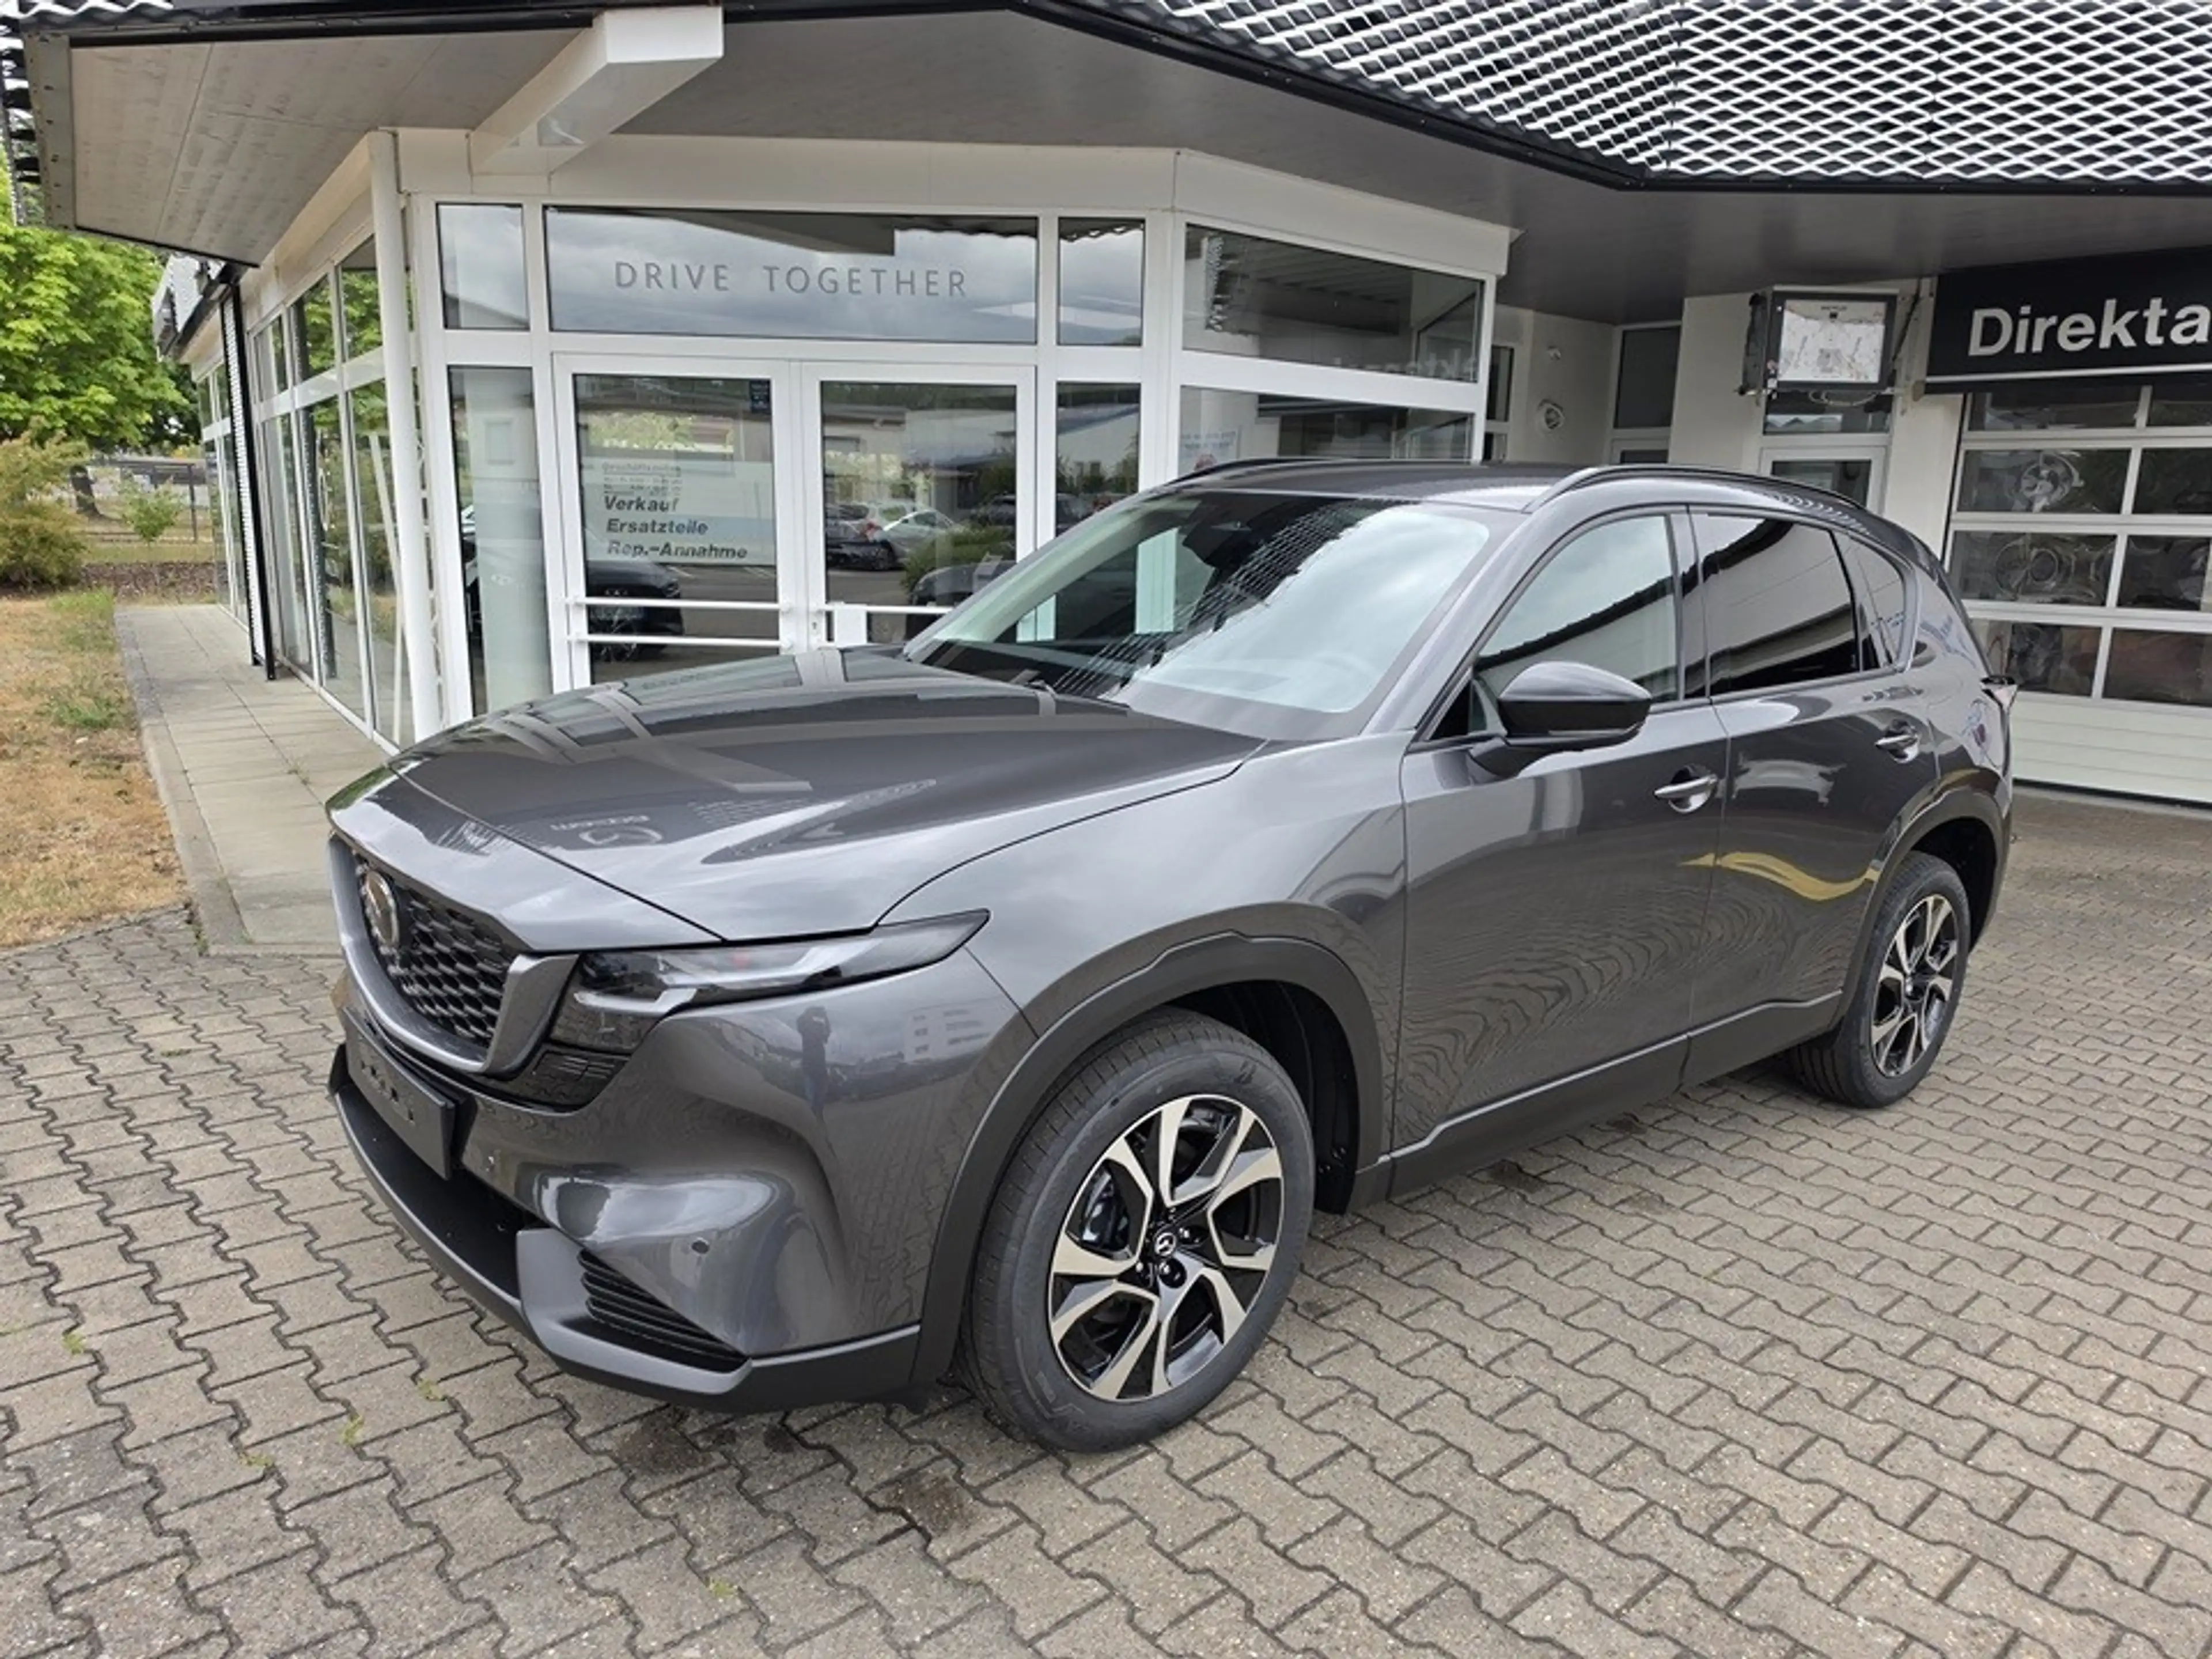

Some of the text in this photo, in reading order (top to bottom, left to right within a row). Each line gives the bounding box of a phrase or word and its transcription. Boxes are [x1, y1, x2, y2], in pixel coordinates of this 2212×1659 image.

[615, 261, 966, 297] DRIVE TOGETHER
[1968, 297, 2211, 357] Direkta
[604, 495, 680, 512] Verkauf
[606, 518, 710, 536] Ersatzteile
[607, 540, 748, 559] Rep.-Annahme
